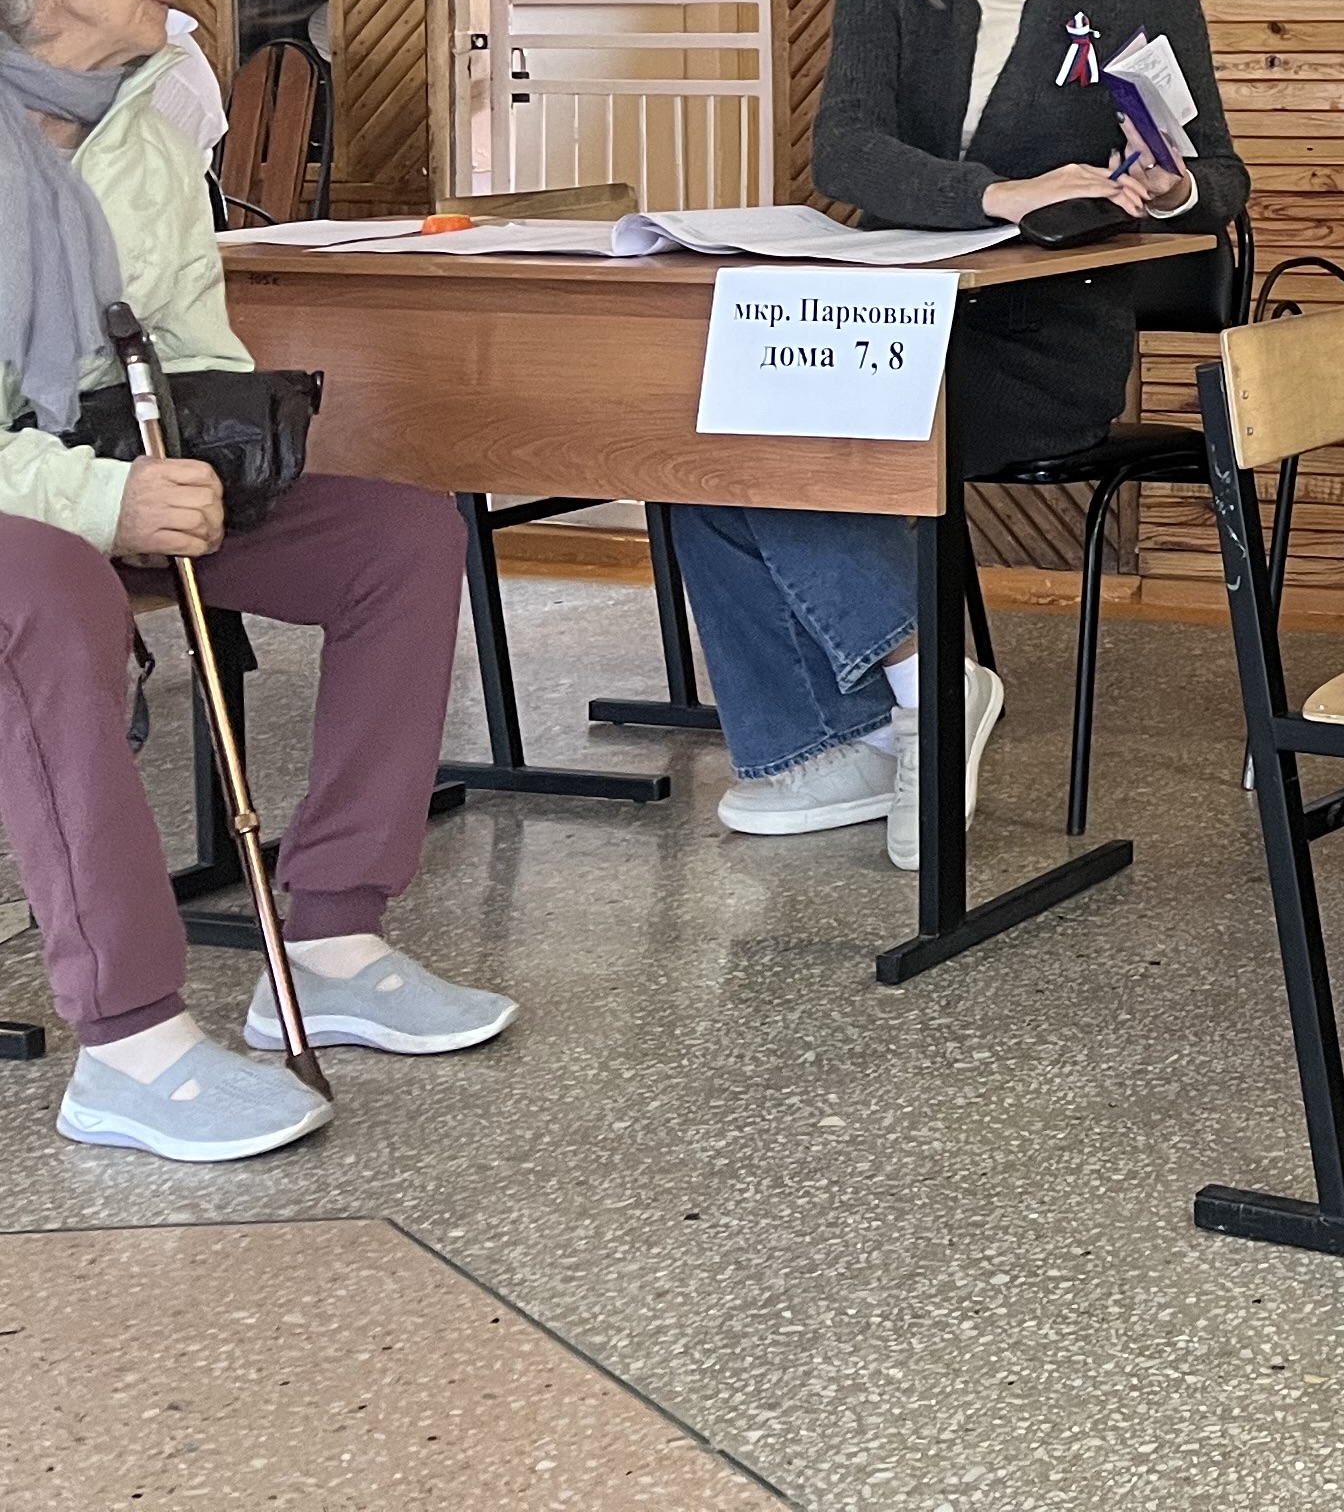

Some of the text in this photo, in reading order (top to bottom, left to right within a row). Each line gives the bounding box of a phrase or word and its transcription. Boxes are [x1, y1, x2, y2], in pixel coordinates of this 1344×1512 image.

[733, 298, 936, 329] мкр. Парковый
[759, 341, 905, 376] дома 7, 8
